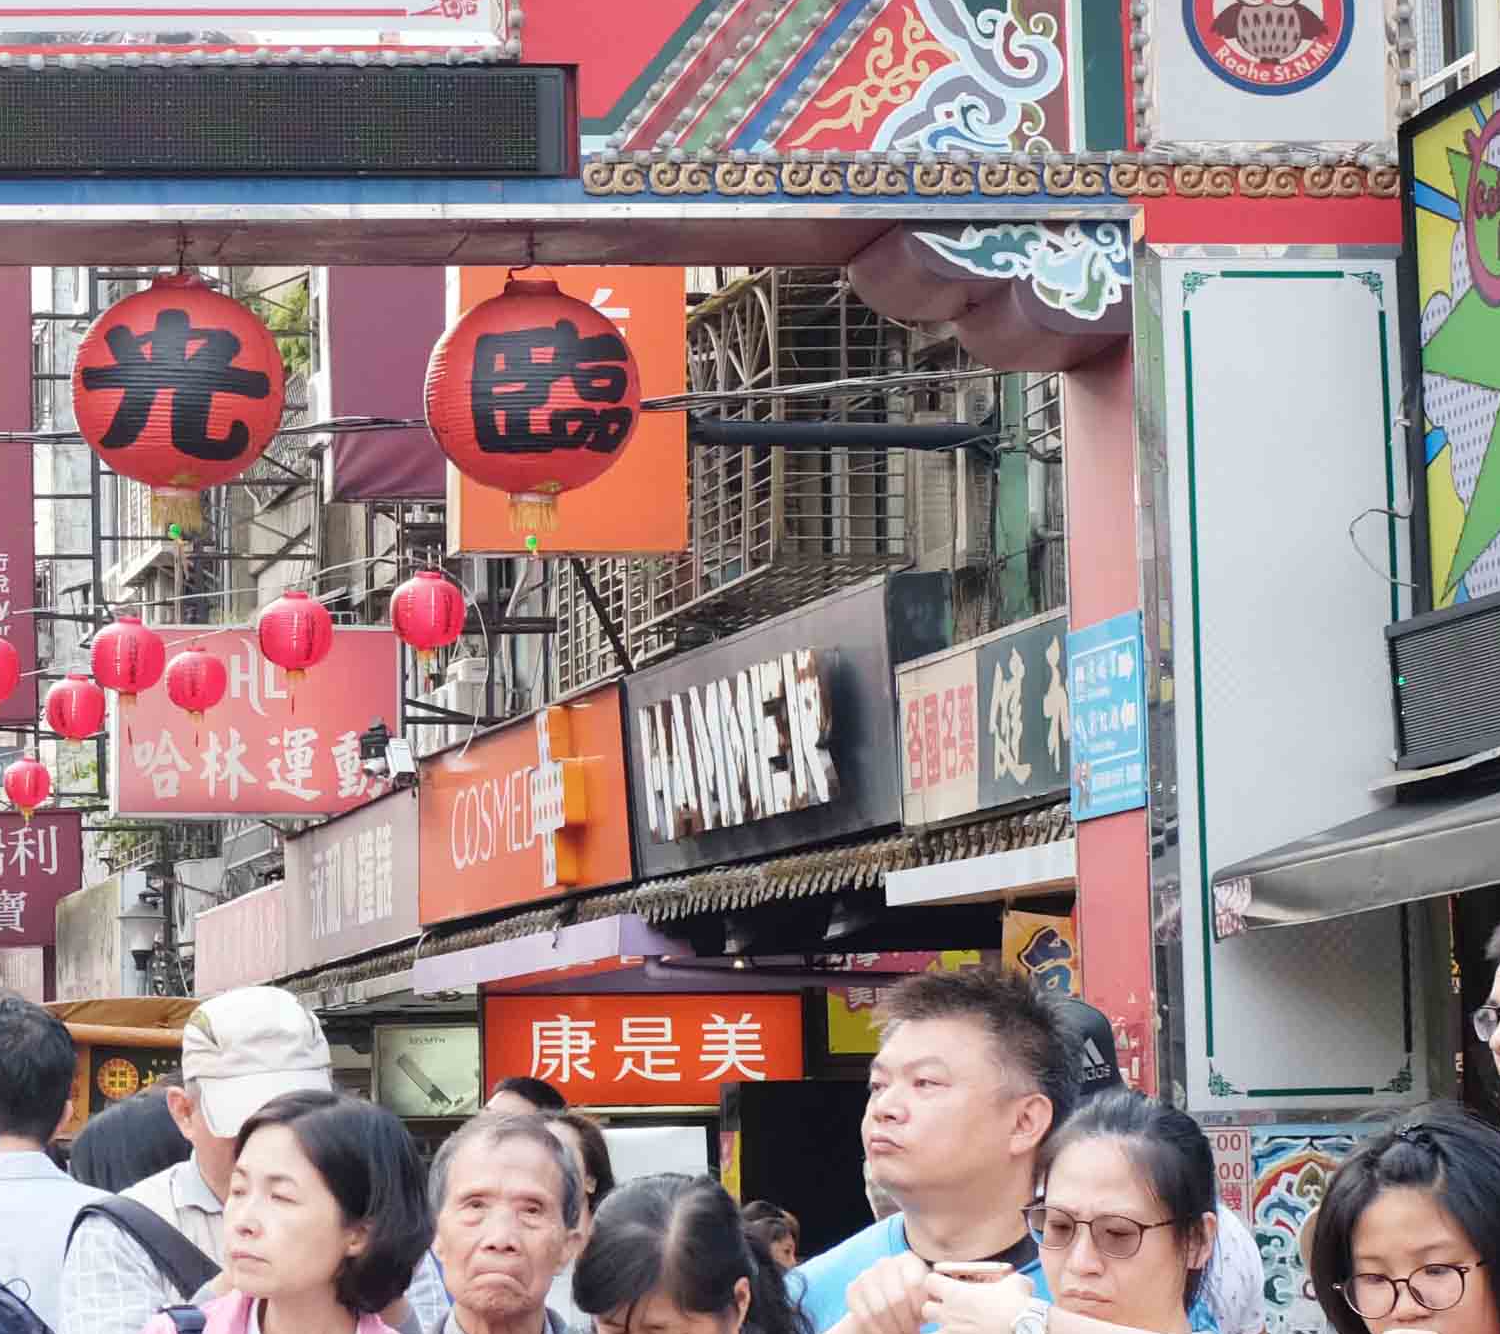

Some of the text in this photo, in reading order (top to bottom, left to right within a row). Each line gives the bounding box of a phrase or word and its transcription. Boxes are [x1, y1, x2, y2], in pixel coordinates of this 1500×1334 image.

[1215, 45, 1270, 82] Raohe
[82, 308, 270, 461] 光
[451, 765, 535, 870] COSMED
[529, 1012, 767, 1083] 康是美
